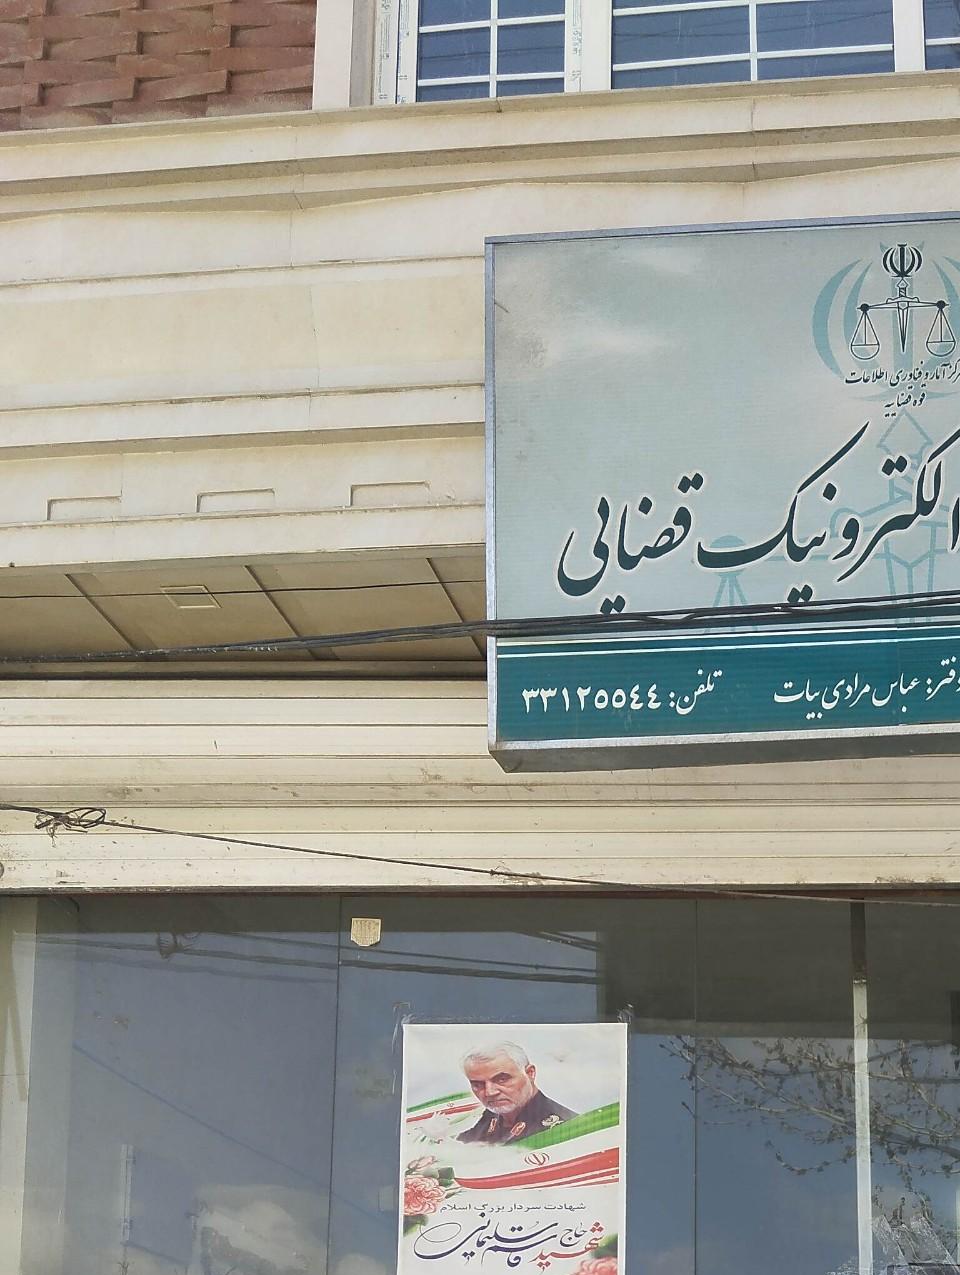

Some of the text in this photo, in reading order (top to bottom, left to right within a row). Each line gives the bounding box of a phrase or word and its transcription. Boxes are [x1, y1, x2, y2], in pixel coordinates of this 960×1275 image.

[844, 369, 888, 384] اطلاعات
[889, 360, 924, 387] فناوری
[924, 370, 929, 380] و
[930, 362, 950, 380] آمار
[912, 383, 927, 407] قوه
[668, 668, 723, 715] تلفن:
[774, 677, 823, 719] بیات
[821, 672, 872, 710] مرادی
[872, 672, 920, 713] عباس
[440, 1202, 586, 1213] شهادت سردار بزرگ اسلام
[413, 1211, 605, 1274] شهید حاج قاسم سلیمانی
